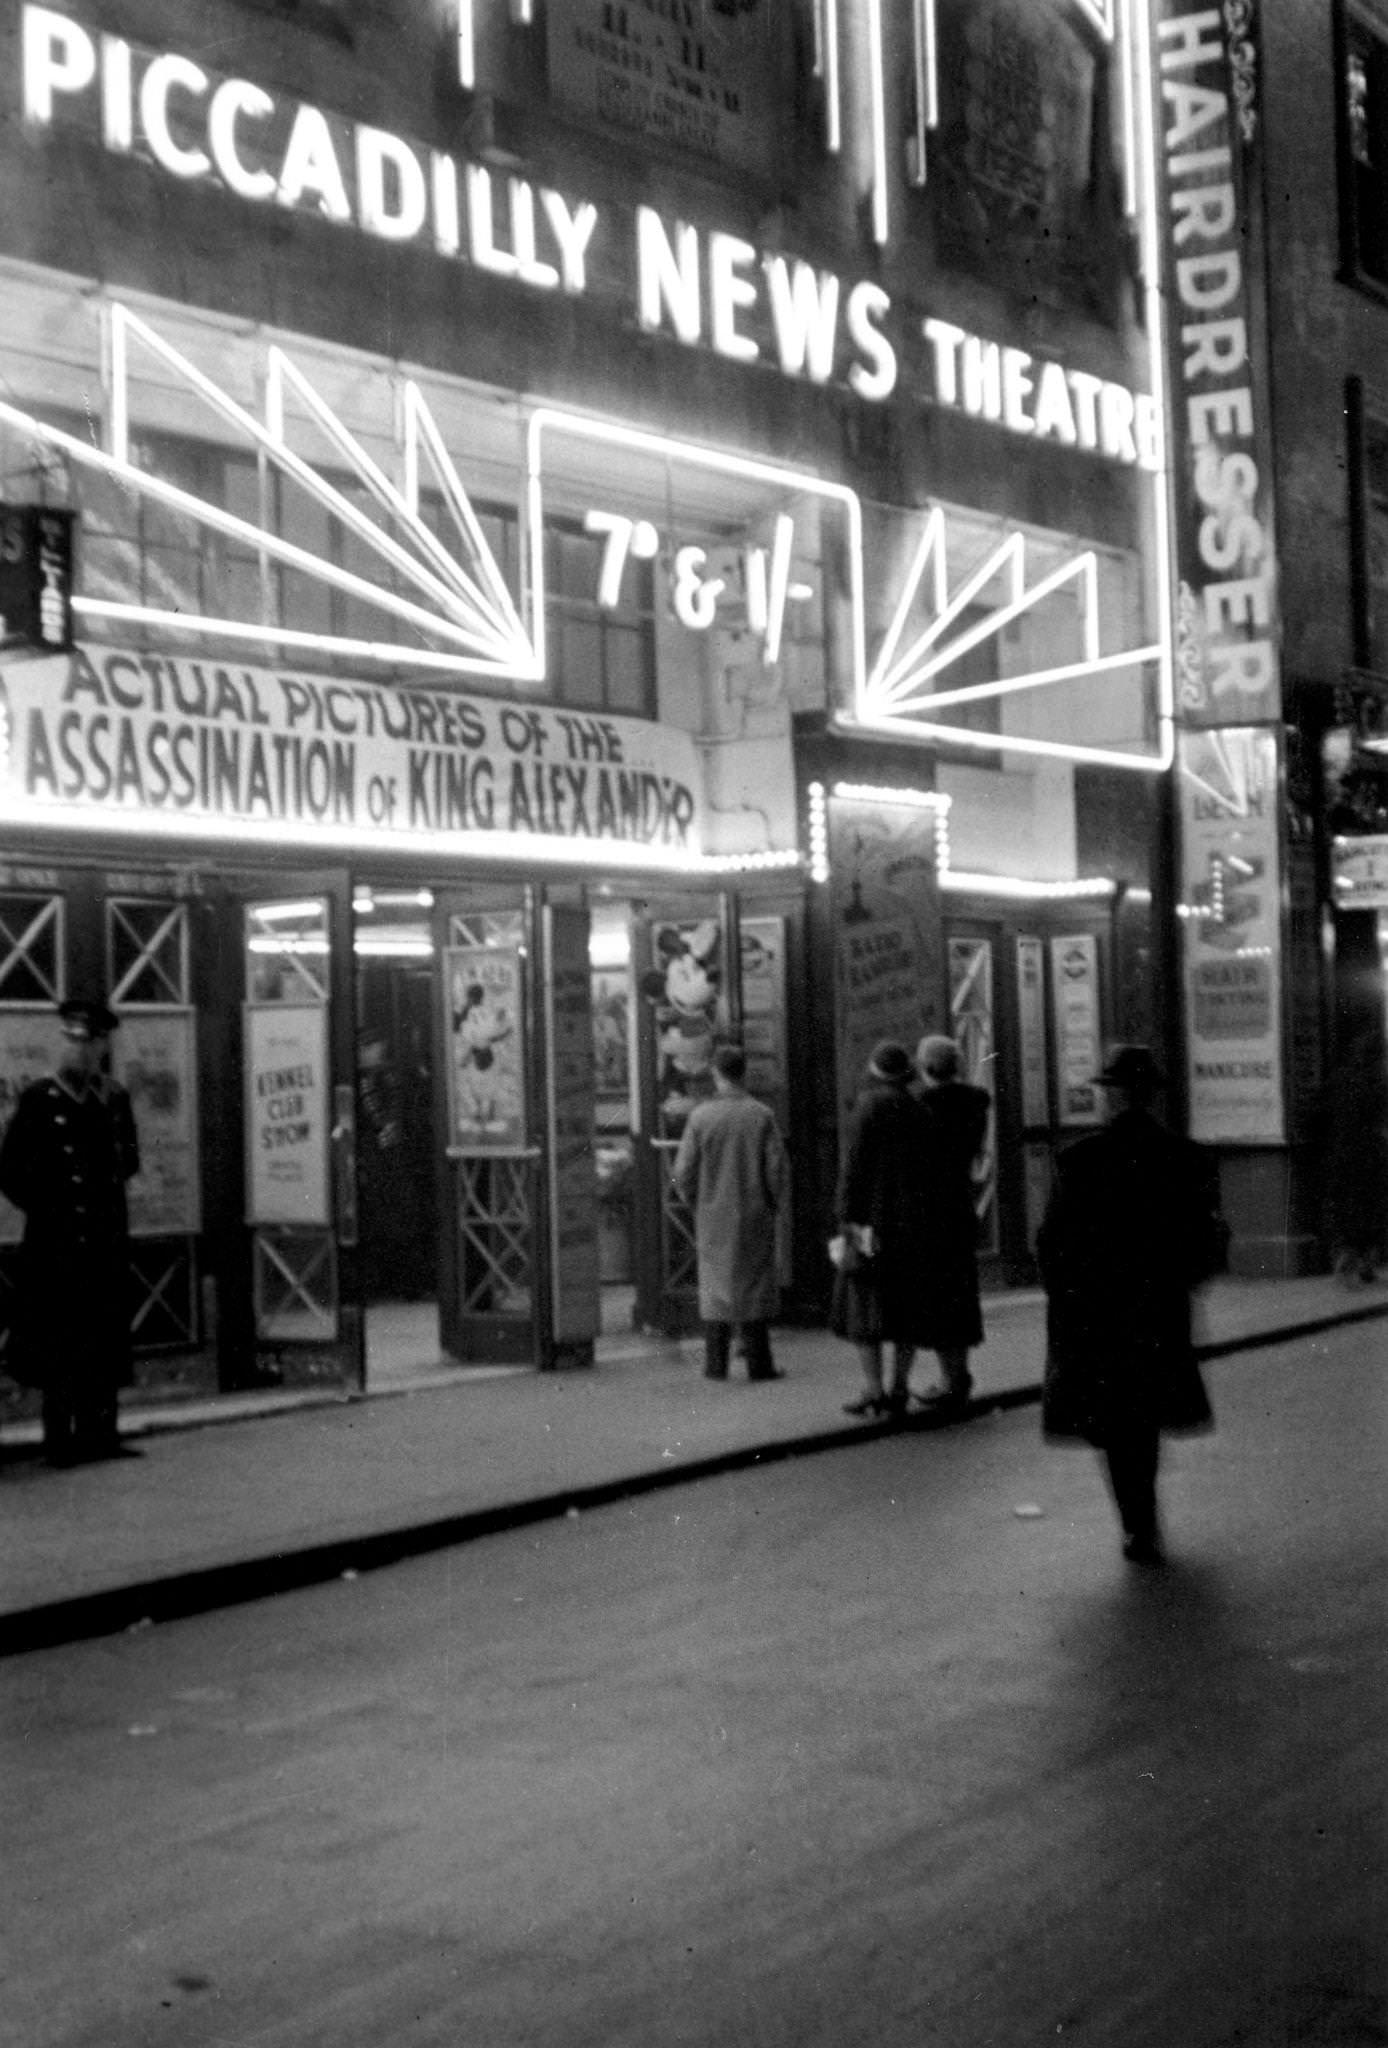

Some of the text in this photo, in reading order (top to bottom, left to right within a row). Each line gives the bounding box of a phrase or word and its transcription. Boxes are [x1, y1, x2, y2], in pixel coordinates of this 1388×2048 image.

[23, 3, 597, 293] PICCADILLY
[637, 204, 897, 401] NEWS
[924, 318, 1165, 471] THEATRE
[1157, 8, 1273, 694] HAIRDRESSER
[675, 546, 725, 629] &
[62, 647, 623, 763] ACTUAL PICTURES OF THE
[25, 706, 356, 823] ASSASSINATION
[367, 775, 396, 823] OF
[408, 747, 495, 831] KING
